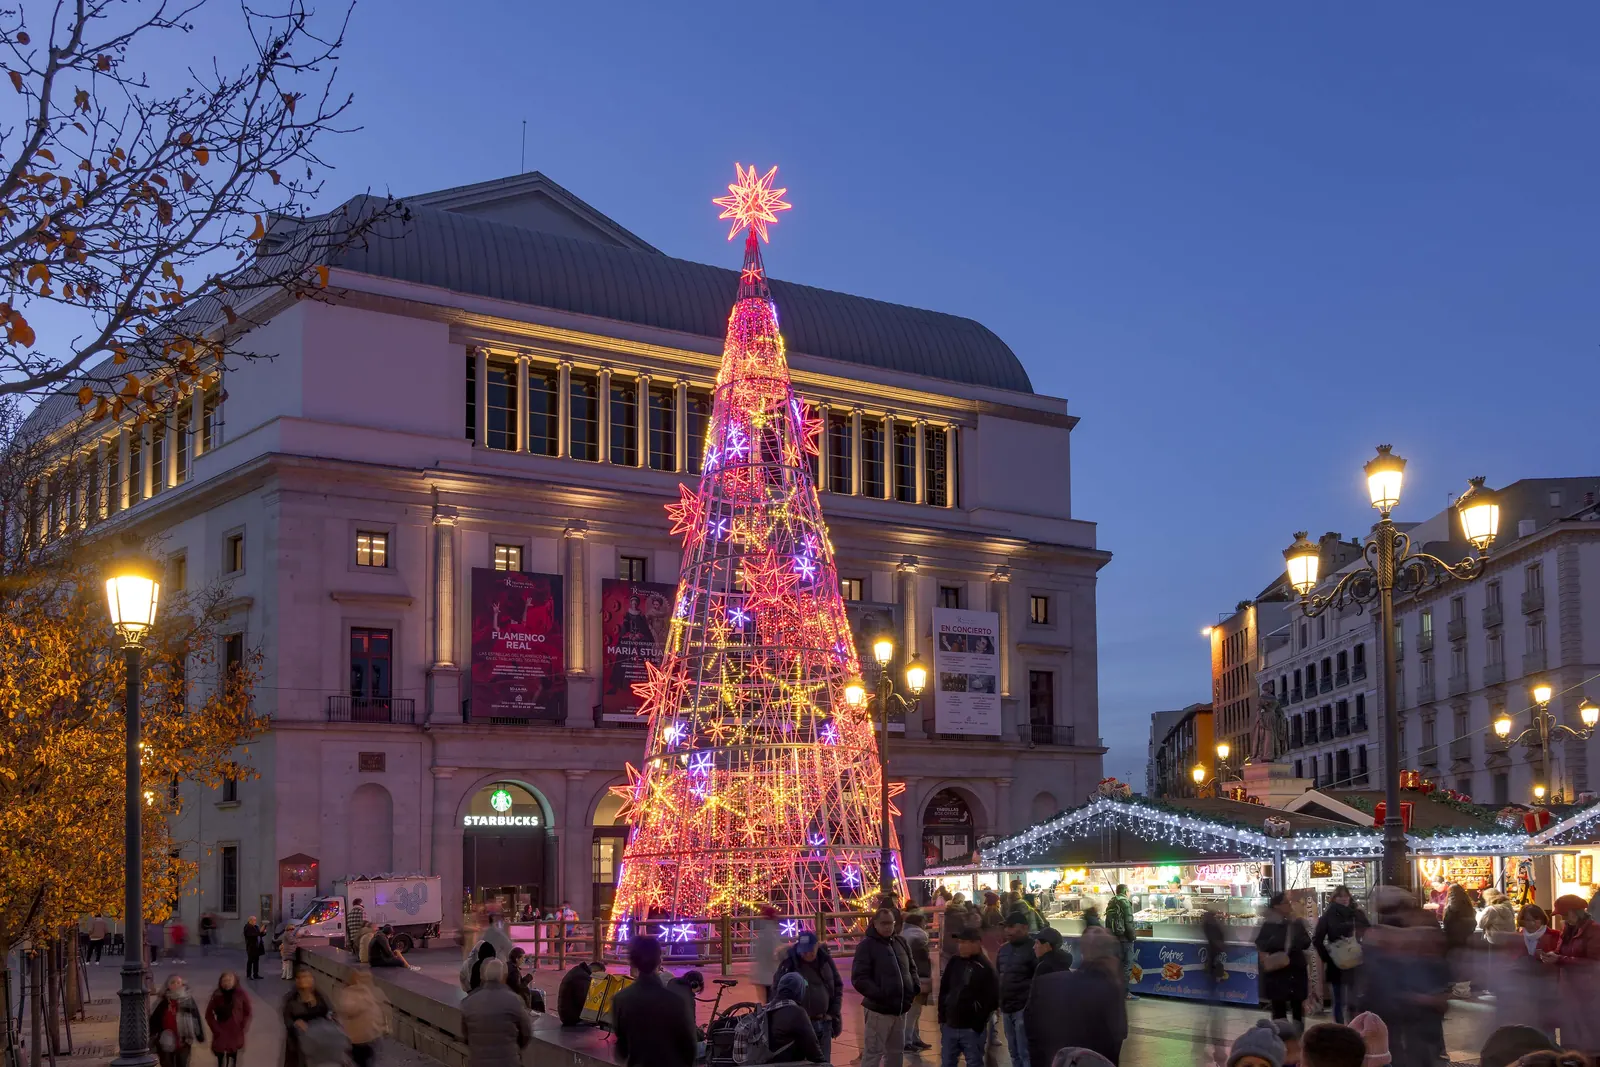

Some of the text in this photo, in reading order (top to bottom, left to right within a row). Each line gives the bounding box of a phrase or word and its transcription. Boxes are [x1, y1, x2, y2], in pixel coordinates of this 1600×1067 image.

[941, 624, 992, 635] EN CONCIERTO
[491, 631, 546, 643] FLAMENCO
[506, 640, 532, 650] REAL
[607, 646, 638, 655] MARIA
[464, 815, 539, 826] STARBUCKS
[1158, 945, 1185, 962] Gofres
